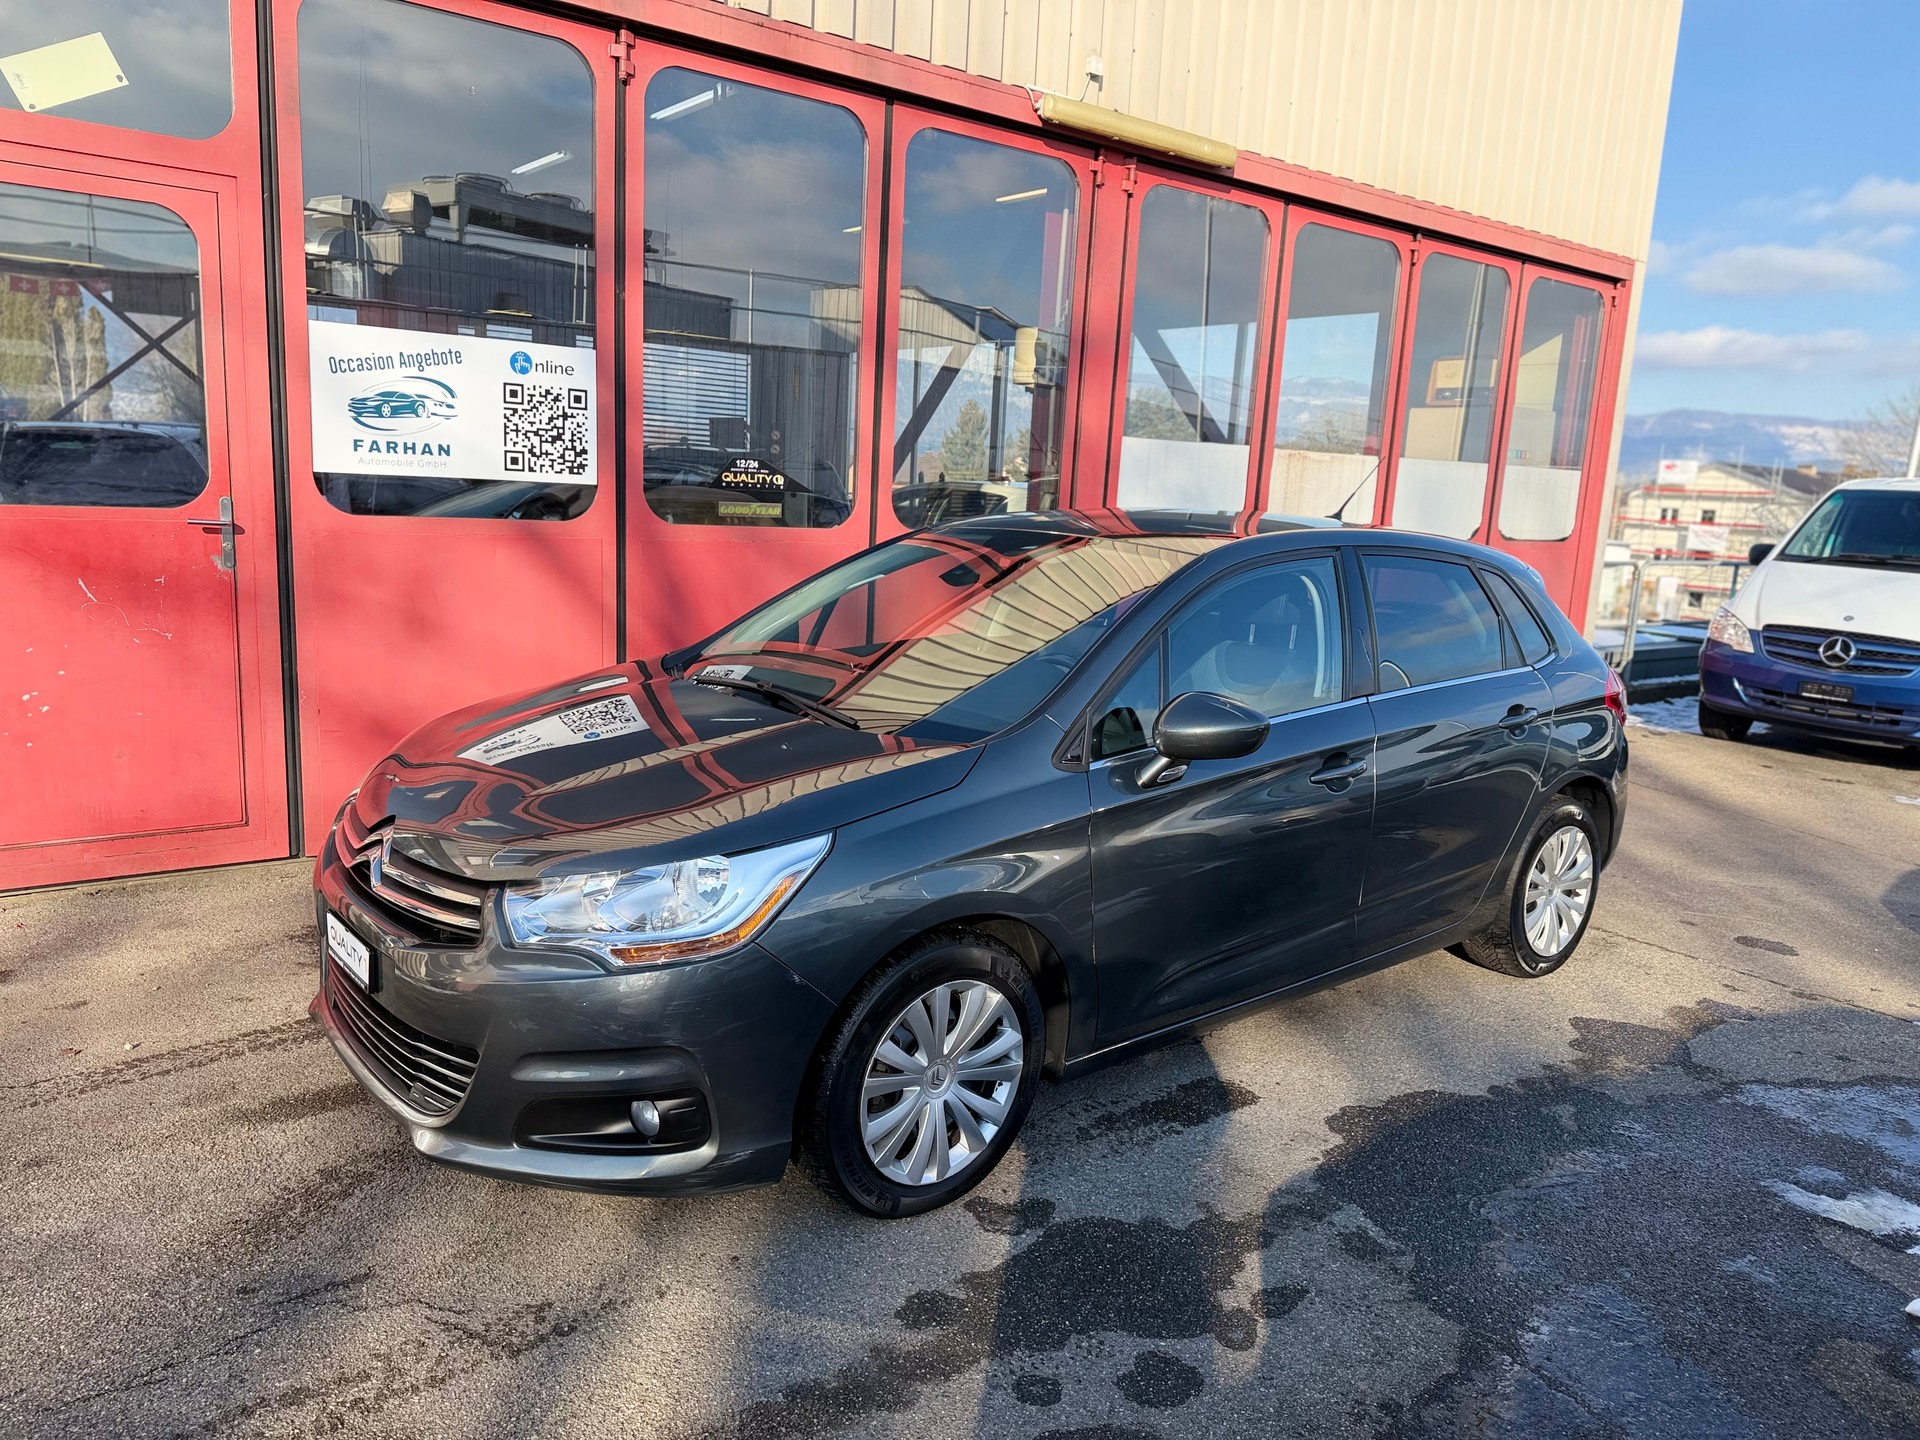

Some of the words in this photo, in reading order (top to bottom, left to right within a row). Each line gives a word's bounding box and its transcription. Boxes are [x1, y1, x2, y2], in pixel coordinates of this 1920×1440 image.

[328, 354, 395, 374] Occasion
[399, 348, 463, 373] Angebote
[353, 439, 451, 457] FARHAN
[358, 456, 415, 467] Automobile
[417, 458, 447, 469] GmbH
[735, 459, 759, 468] 12/24
[330, 925, 363, 968] QUALITY
